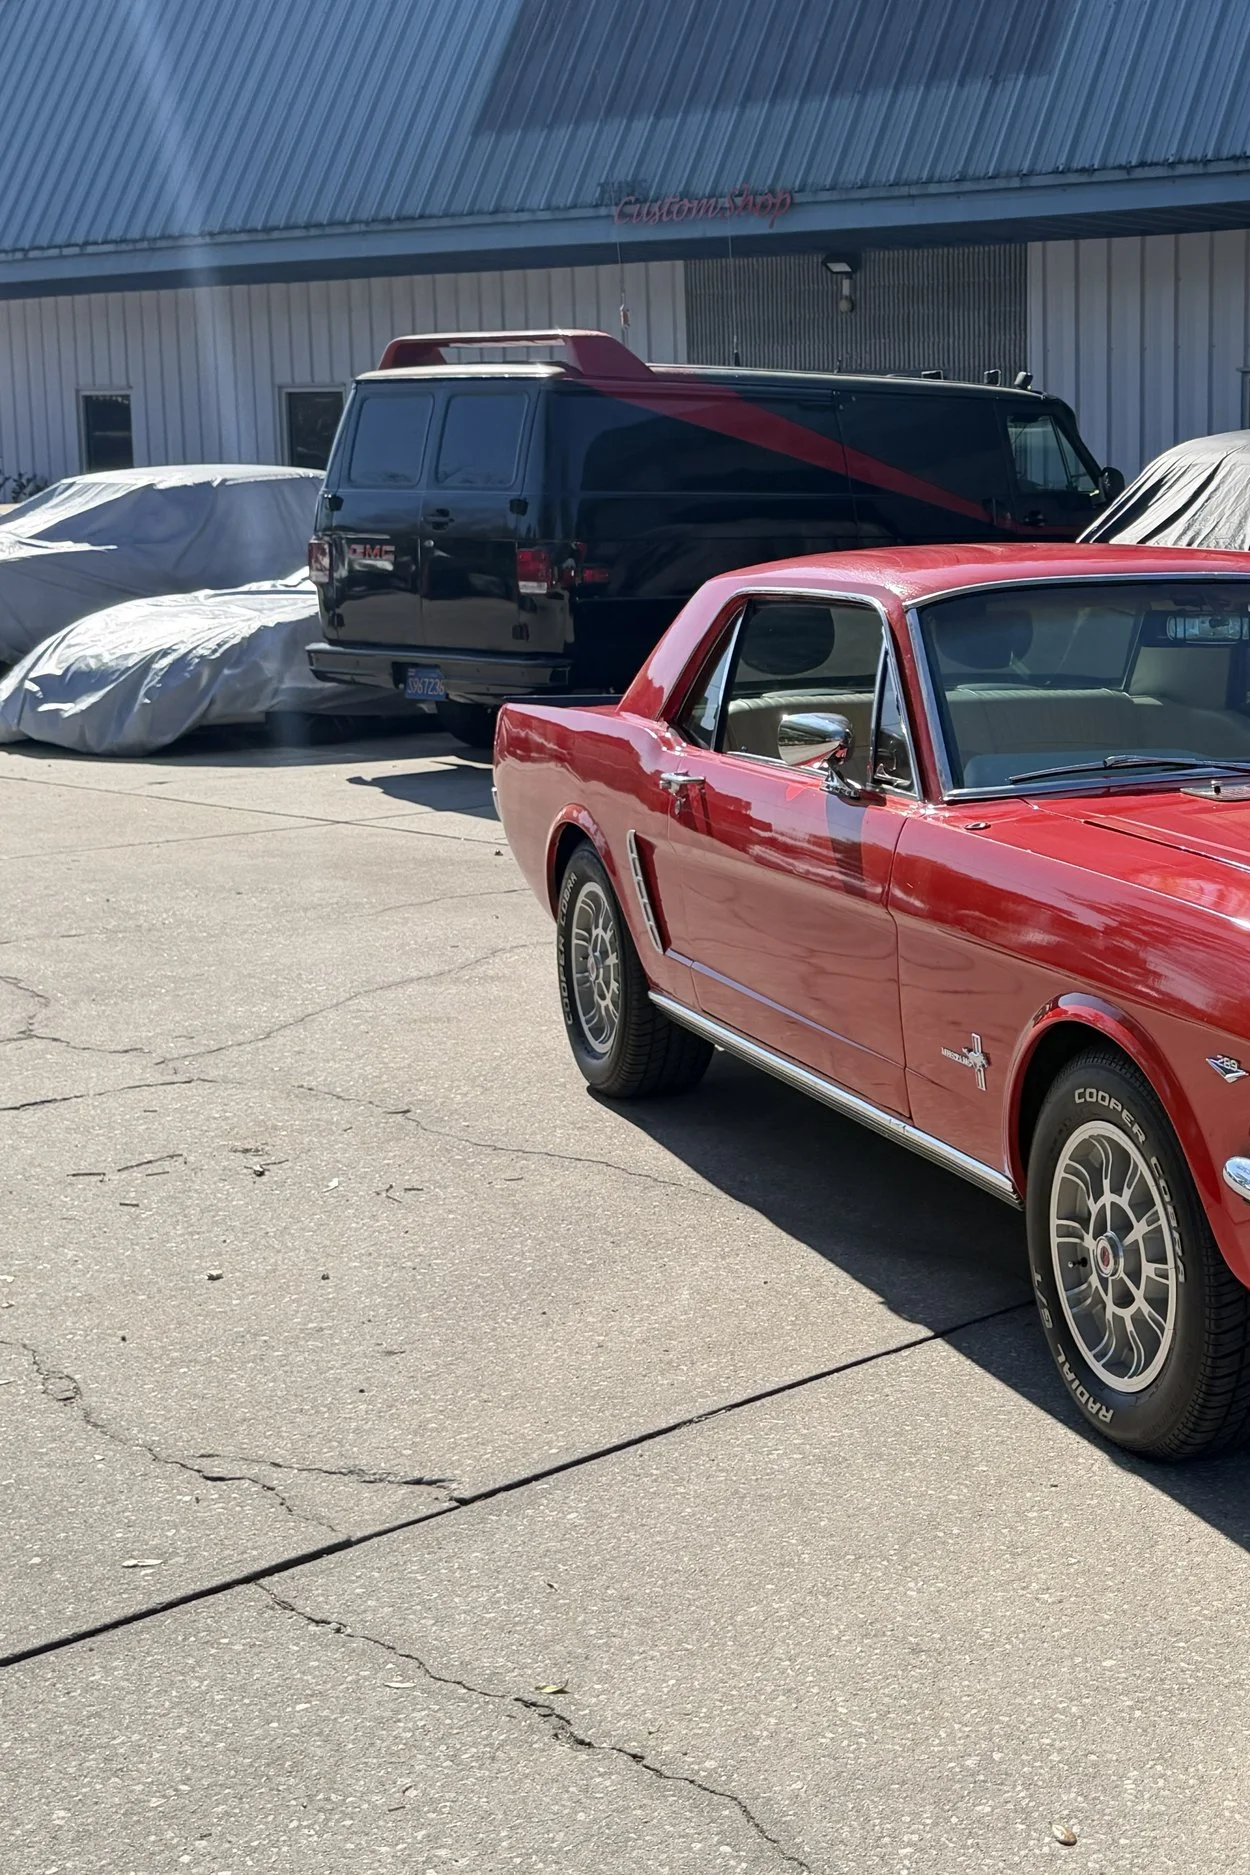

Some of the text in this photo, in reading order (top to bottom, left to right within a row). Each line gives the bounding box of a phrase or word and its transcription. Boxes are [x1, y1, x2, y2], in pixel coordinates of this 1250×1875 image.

[614, 194, 721, 225] Custom
[348, 544, 395, 561] GMC
[558, 872, 578, 1025] COOPER COBRA
[1216, 1054, 1238, 1071] 289
[1074, 1087, 1186, 1283] COOPER COBRA
[1056, 1343, 1115, 1424] RADIAL
